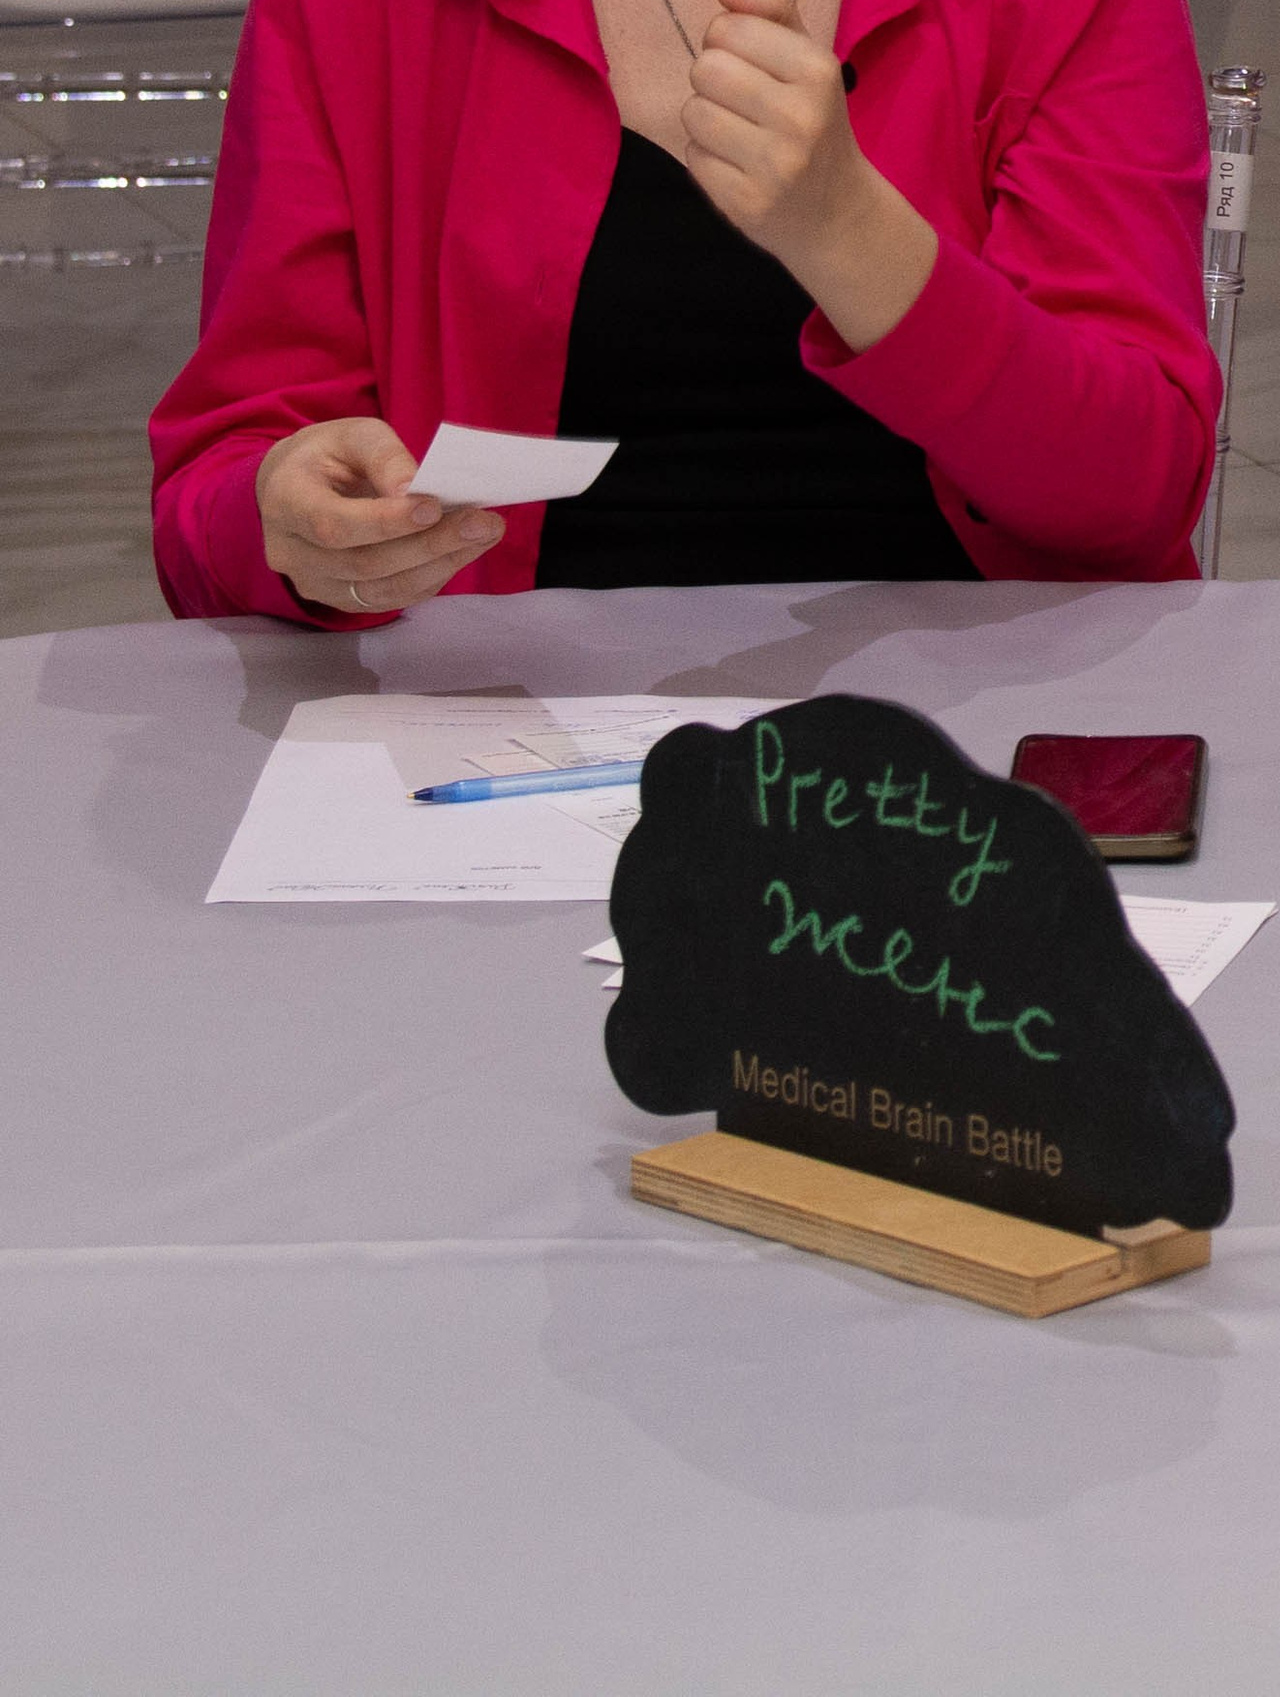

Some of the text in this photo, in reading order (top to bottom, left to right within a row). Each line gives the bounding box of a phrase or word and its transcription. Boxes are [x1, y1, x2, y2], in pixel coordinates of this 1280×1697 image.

[1216, 162, 1236, 218] Ряд 10
[754, 719, 1013, 906] Pretty
[732, 1049, 1063, 1178] Medical Brain Battle
